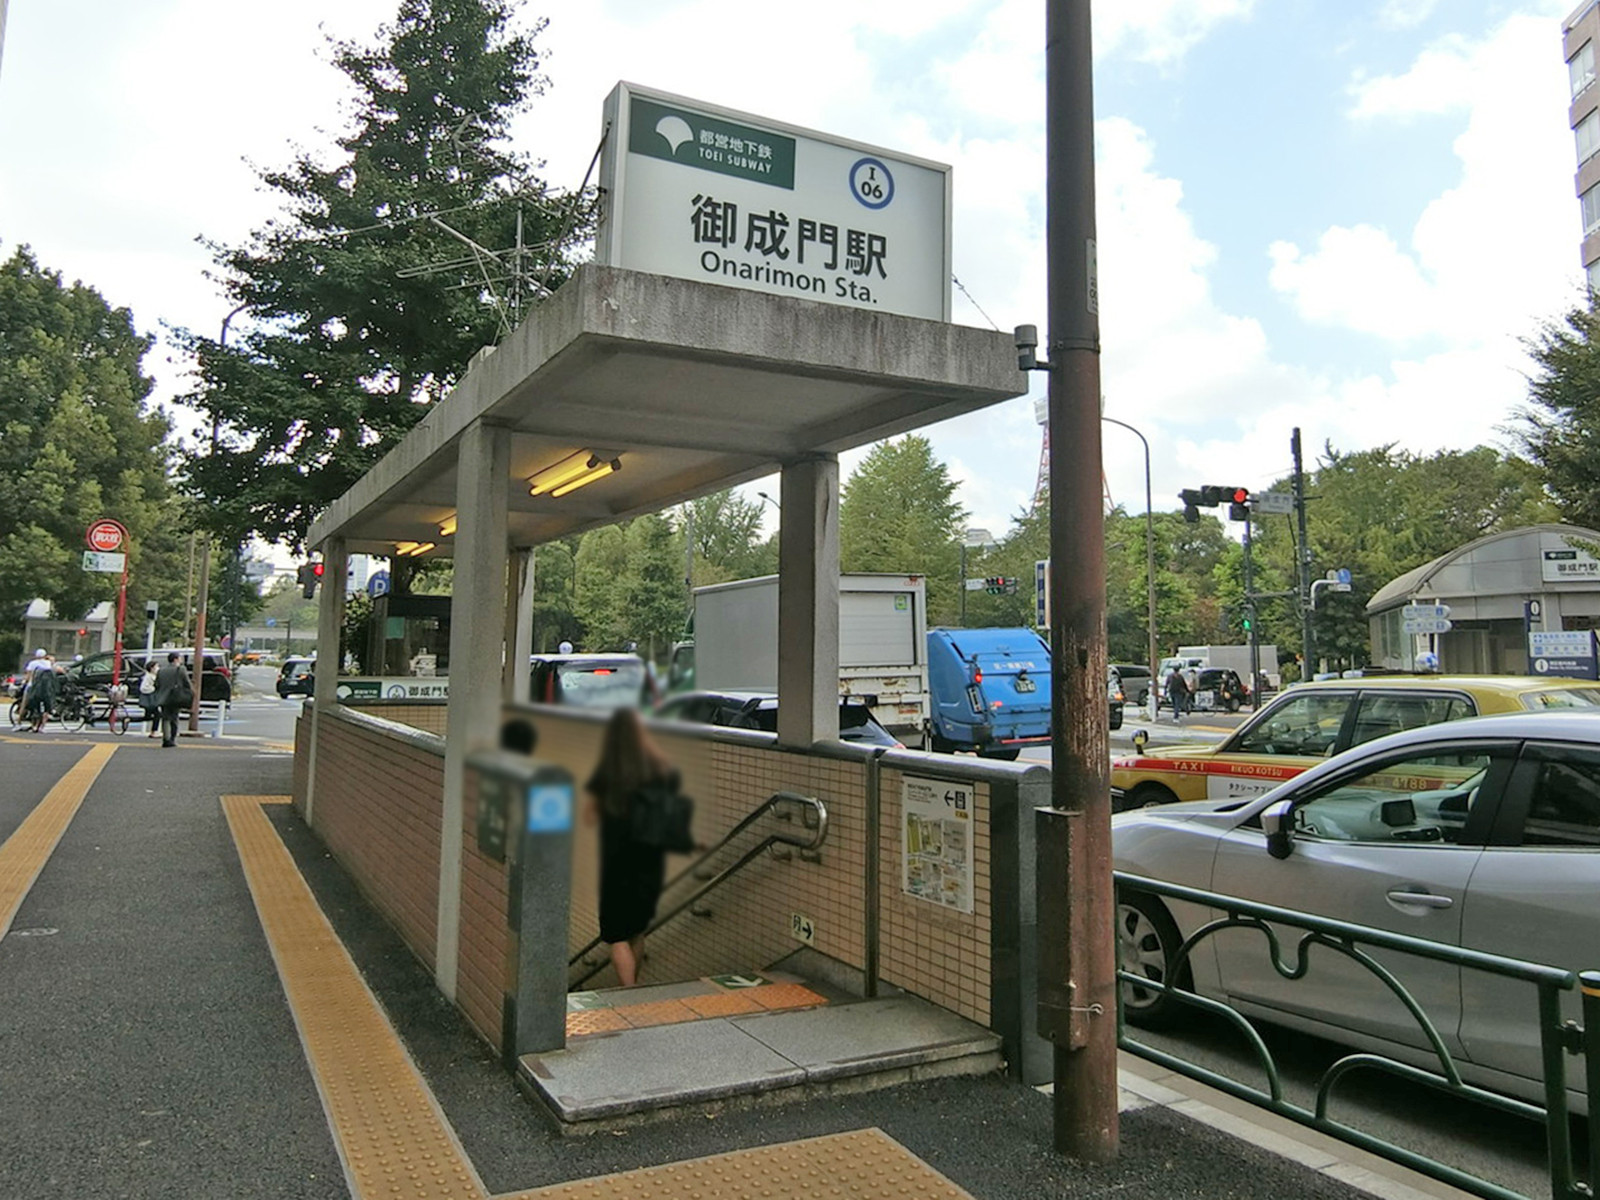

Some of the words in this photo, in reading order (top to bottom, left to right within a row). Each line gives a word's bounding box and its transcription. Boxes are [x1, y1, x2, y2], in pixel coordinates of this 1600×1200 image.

[700, 129, 772, 160] 都営地下鉄
[699, 146, 723, 162] TOEI
[727, 154, 772, 173] SUBWAY
[869, 166, 876, 181] I
[861, 181, 883, 199] 06
[691, 194, 887, 280] 御成門駅
[700, 250, 826, 294] Onarimon
[835, 276, 878, 304] Sta.
[1173, 761, 1204, 771] TAXI
